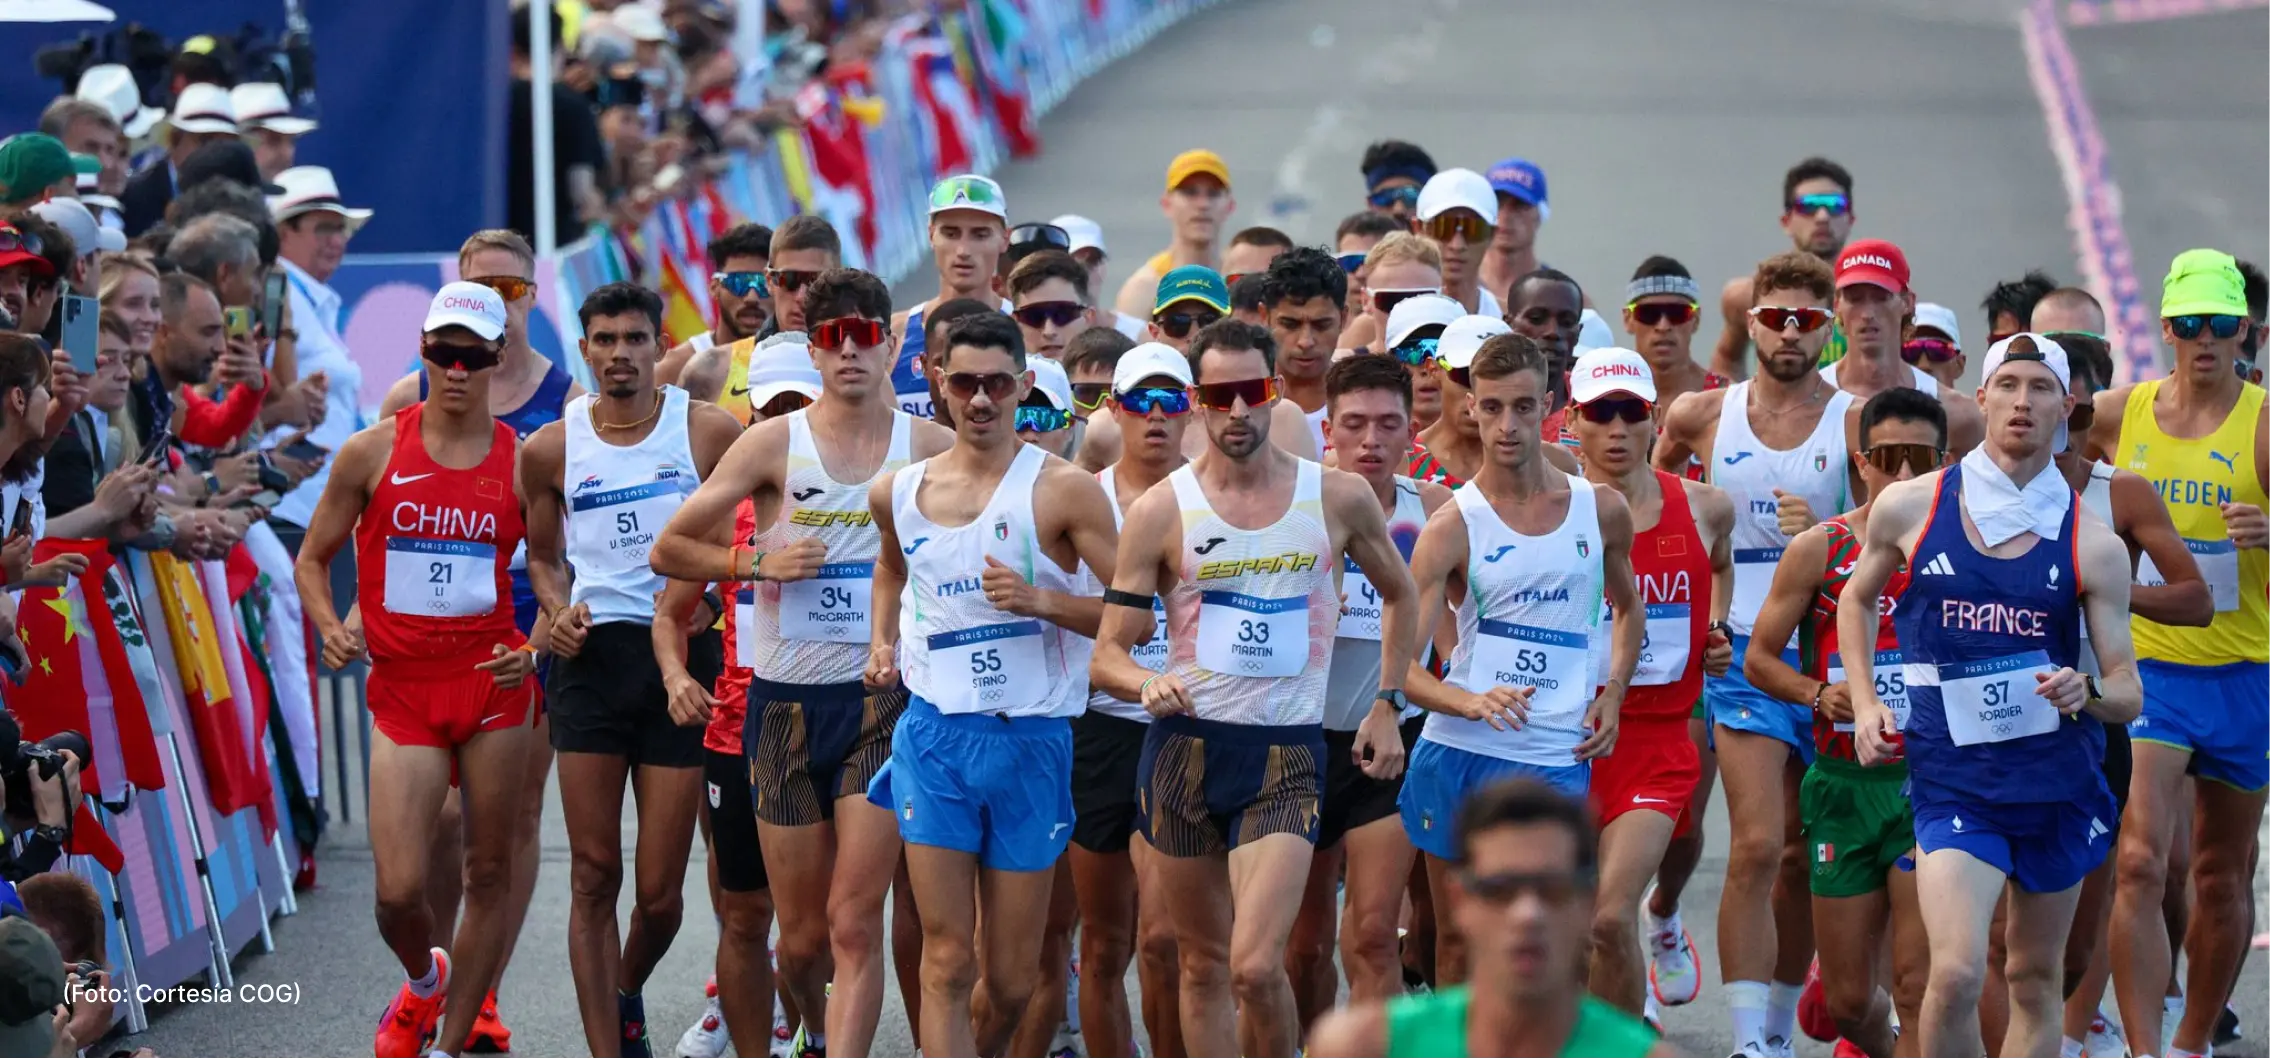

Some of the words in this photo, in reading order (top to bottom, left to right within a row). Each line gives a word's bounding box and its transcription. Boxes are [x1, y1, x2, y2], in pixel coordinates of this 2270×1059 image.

[1843, 253, 1892, 270] CANADA
[444, 297, 485, 312] CHINA
[1592, 363, 1641, 379] CHINA
[655, 470, 680, 481] INDIA
[596, 492, 622, 504] PARIS
[624, 489, 649, 499] 2024
[2152, 478, 2232, 506] WEDEN
[1749, 499, 1776, 514] ITA
[392, 501, 496, 539] CHINA
[617, 510, 639, 534] 51
[789, 507, 873, 528] ESPA
[415, 542, 442, 551] PARIS
[620, 533, 653, 548] SINGH
[429, 562, 452, 584] 21
[820, 567, 836, 576] RIS
[839, 566, 865, 575] 2024
[1197, 552, 1317, 580] ESPAÑA
[435, 587, 443, 597] LI
[937, 577, 981, 597] ITALI
[1634, 570, 1690, 604] INA
[820, 586, 851, 609] 34
[1232, 596, 1256, 608] PARIS
[1259, 603, 1282, 611] 2024
[1514, 588, 1570, 603] ITALIA
[808, 611, 864, 622] McGRATH
[1349, 606, 1381, 619] ARRO
[1942, 599, 2049, 637] FRANCE
[985, 627, 1011, 637] 2024
[1238, 619, 1269, 644] 33
[1508, 626, 1535, 638] PARIS
[1540, 632, 1564, 642] 2024
[1133, 644, 1168, 656] HURTA
[1231, 644, 1273, 657] MARTIN
[971, 648, 1001, 674] 55
[1515, 649, 1547, 674] 53
[1965, 664, 1993, 674] PARIS
[1996, 659, 2021, 669] 2024
[972, 673, 1007, 689] STANO
[1495, 670, 1558, 690] FORTUNATO
[1875, 672, 1905, 696] 65
[1983, 680, 2010, 706] 37
[1883, 698, 1906, 709] RTIZ
